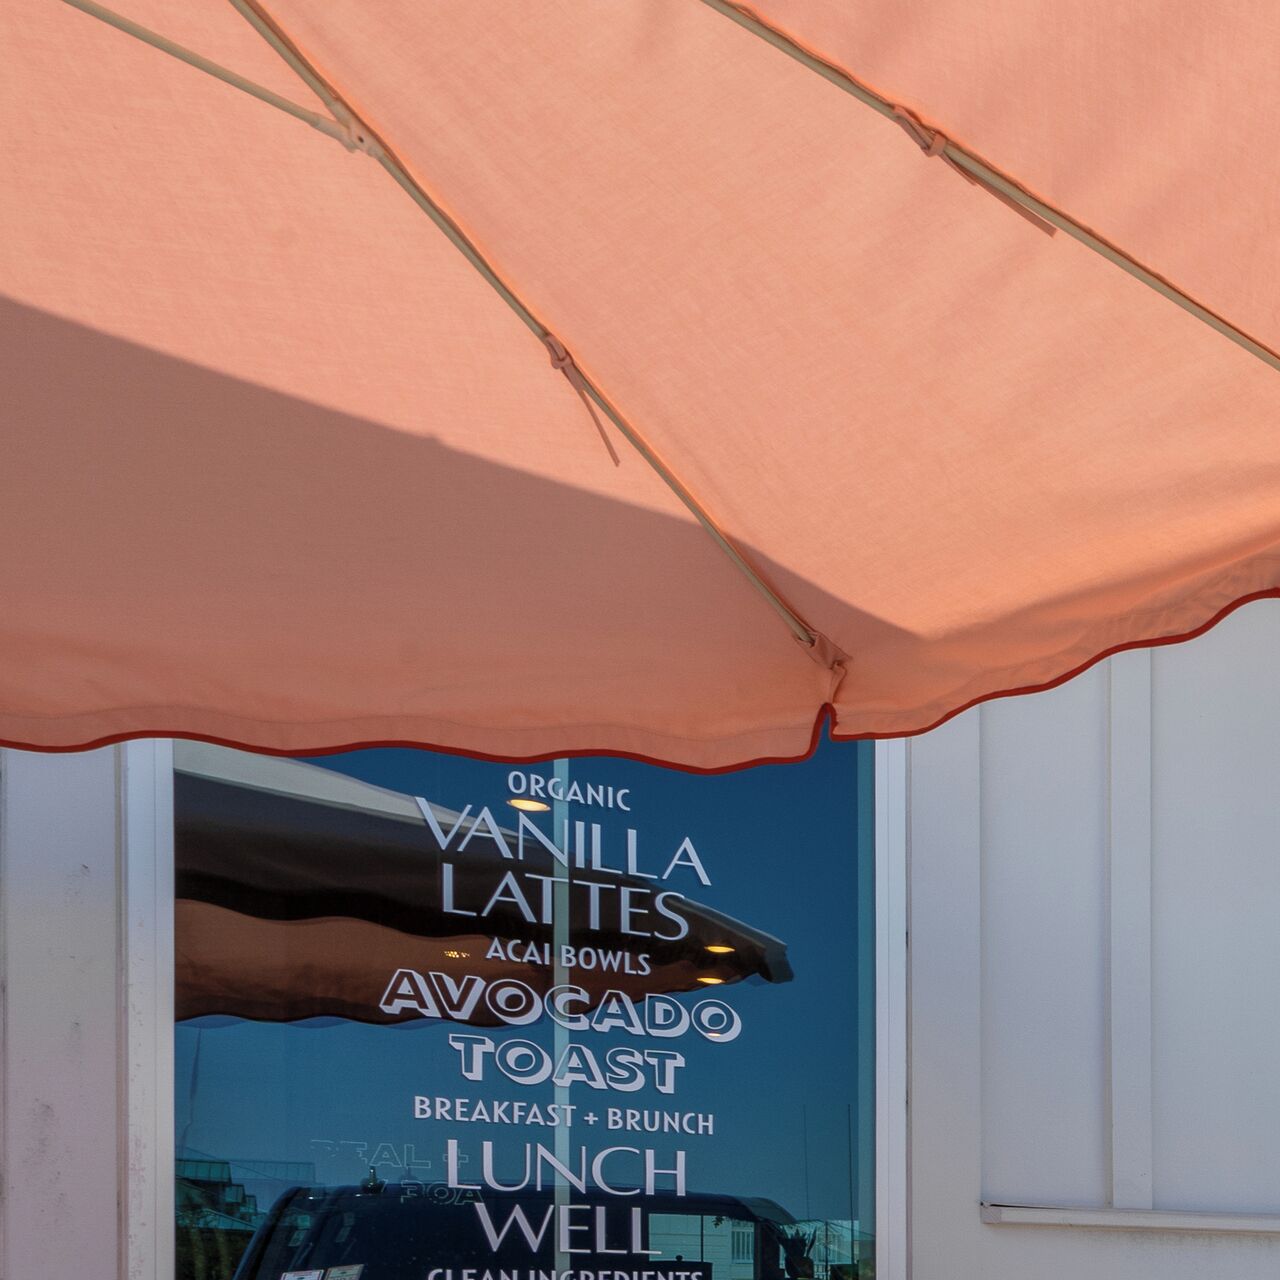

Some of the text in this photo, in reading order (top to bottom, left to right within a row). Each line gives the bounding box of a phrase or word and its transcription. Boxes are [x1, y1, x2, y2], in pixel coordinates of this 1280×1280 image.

[507, 770, 631, 811] ORGANIC
[415, 796, 712, 886] VANILLA
[442, 863, 690, 942] LATTES
[486, 938, 652, 976] ACAI BOWLS
[379, 969, 742, 1044] AVOCADO
[449, 1034, 686, 1094] TOAST
[413, 1096, 577, 1128] BREAKFAST
[607, 1107, 714, 1136] BRUNCH
[447, 1139, 686, 1197] LUNCH
[474, 1203, 662, 1255] WELL
